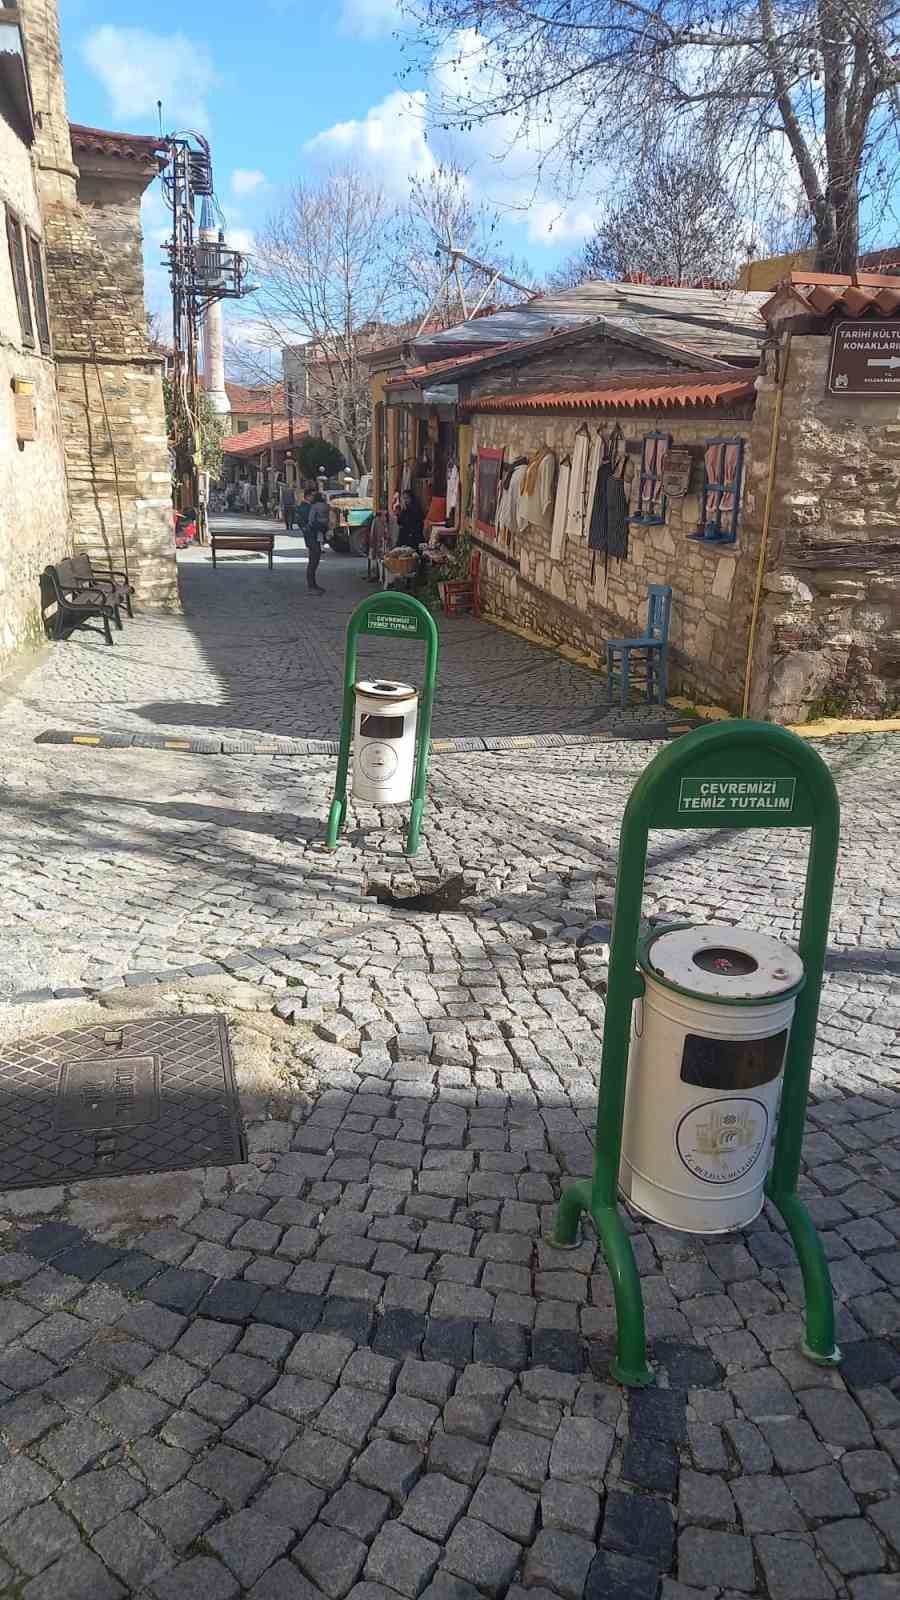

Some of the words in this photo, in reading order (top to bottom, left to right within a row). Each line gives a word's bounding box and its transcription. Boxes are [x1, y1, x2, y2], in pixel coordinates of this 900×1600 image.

[840, 329, 871, 338] TARİHİ
[843, 342, 900, 350] KONAKLARI
[700, 781, 777, 796] ÇEVREMİZİ
[683, 795, 726, 809] TEMİZ
[730, 797, 790, 809] TUTALIM
